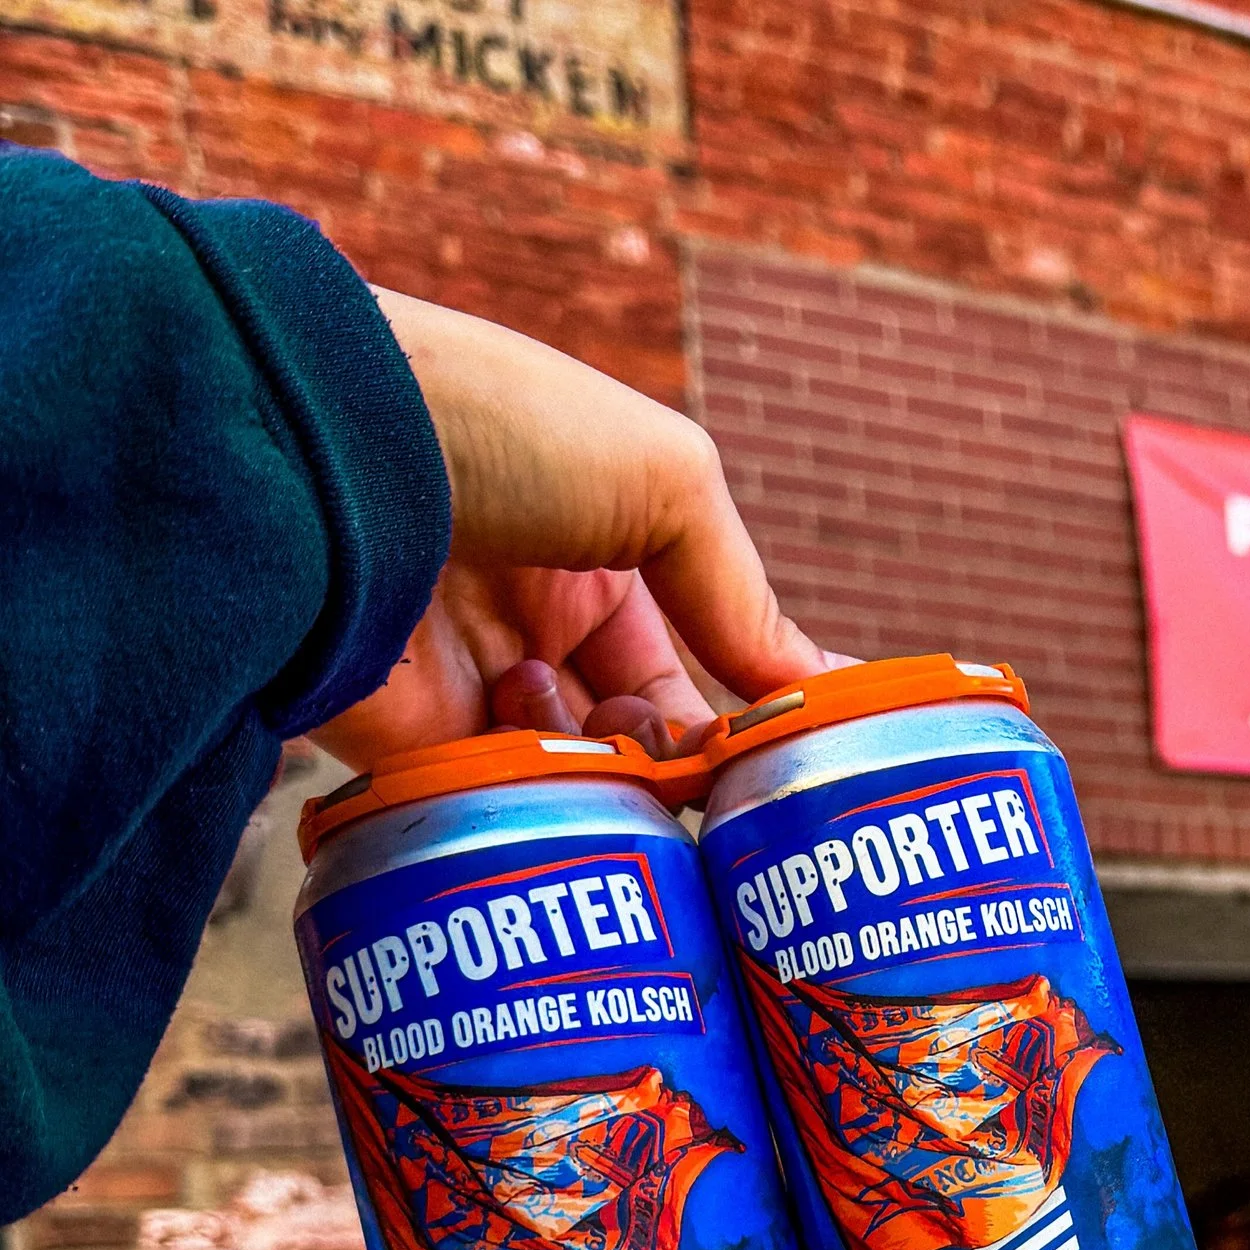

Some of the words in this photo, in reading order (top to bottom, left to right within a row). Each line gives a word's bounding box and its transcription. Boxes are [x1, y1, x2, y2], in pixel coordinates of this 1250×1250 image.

[736, 789, 1039, 951] SUPPORTER
[326, 873, 657, 1039] SUPPORTER
[775, 931, 854, 984] BLOOD
[861, 907, 977, 960] ORANGE
[984, 897, 1074, 937] KOLSCH
[364, 1018, 444, 1073] BLOOD
[452, 992, 582, 1048] ORANGE
[591, 987, 693, 1026] KOLSCH
